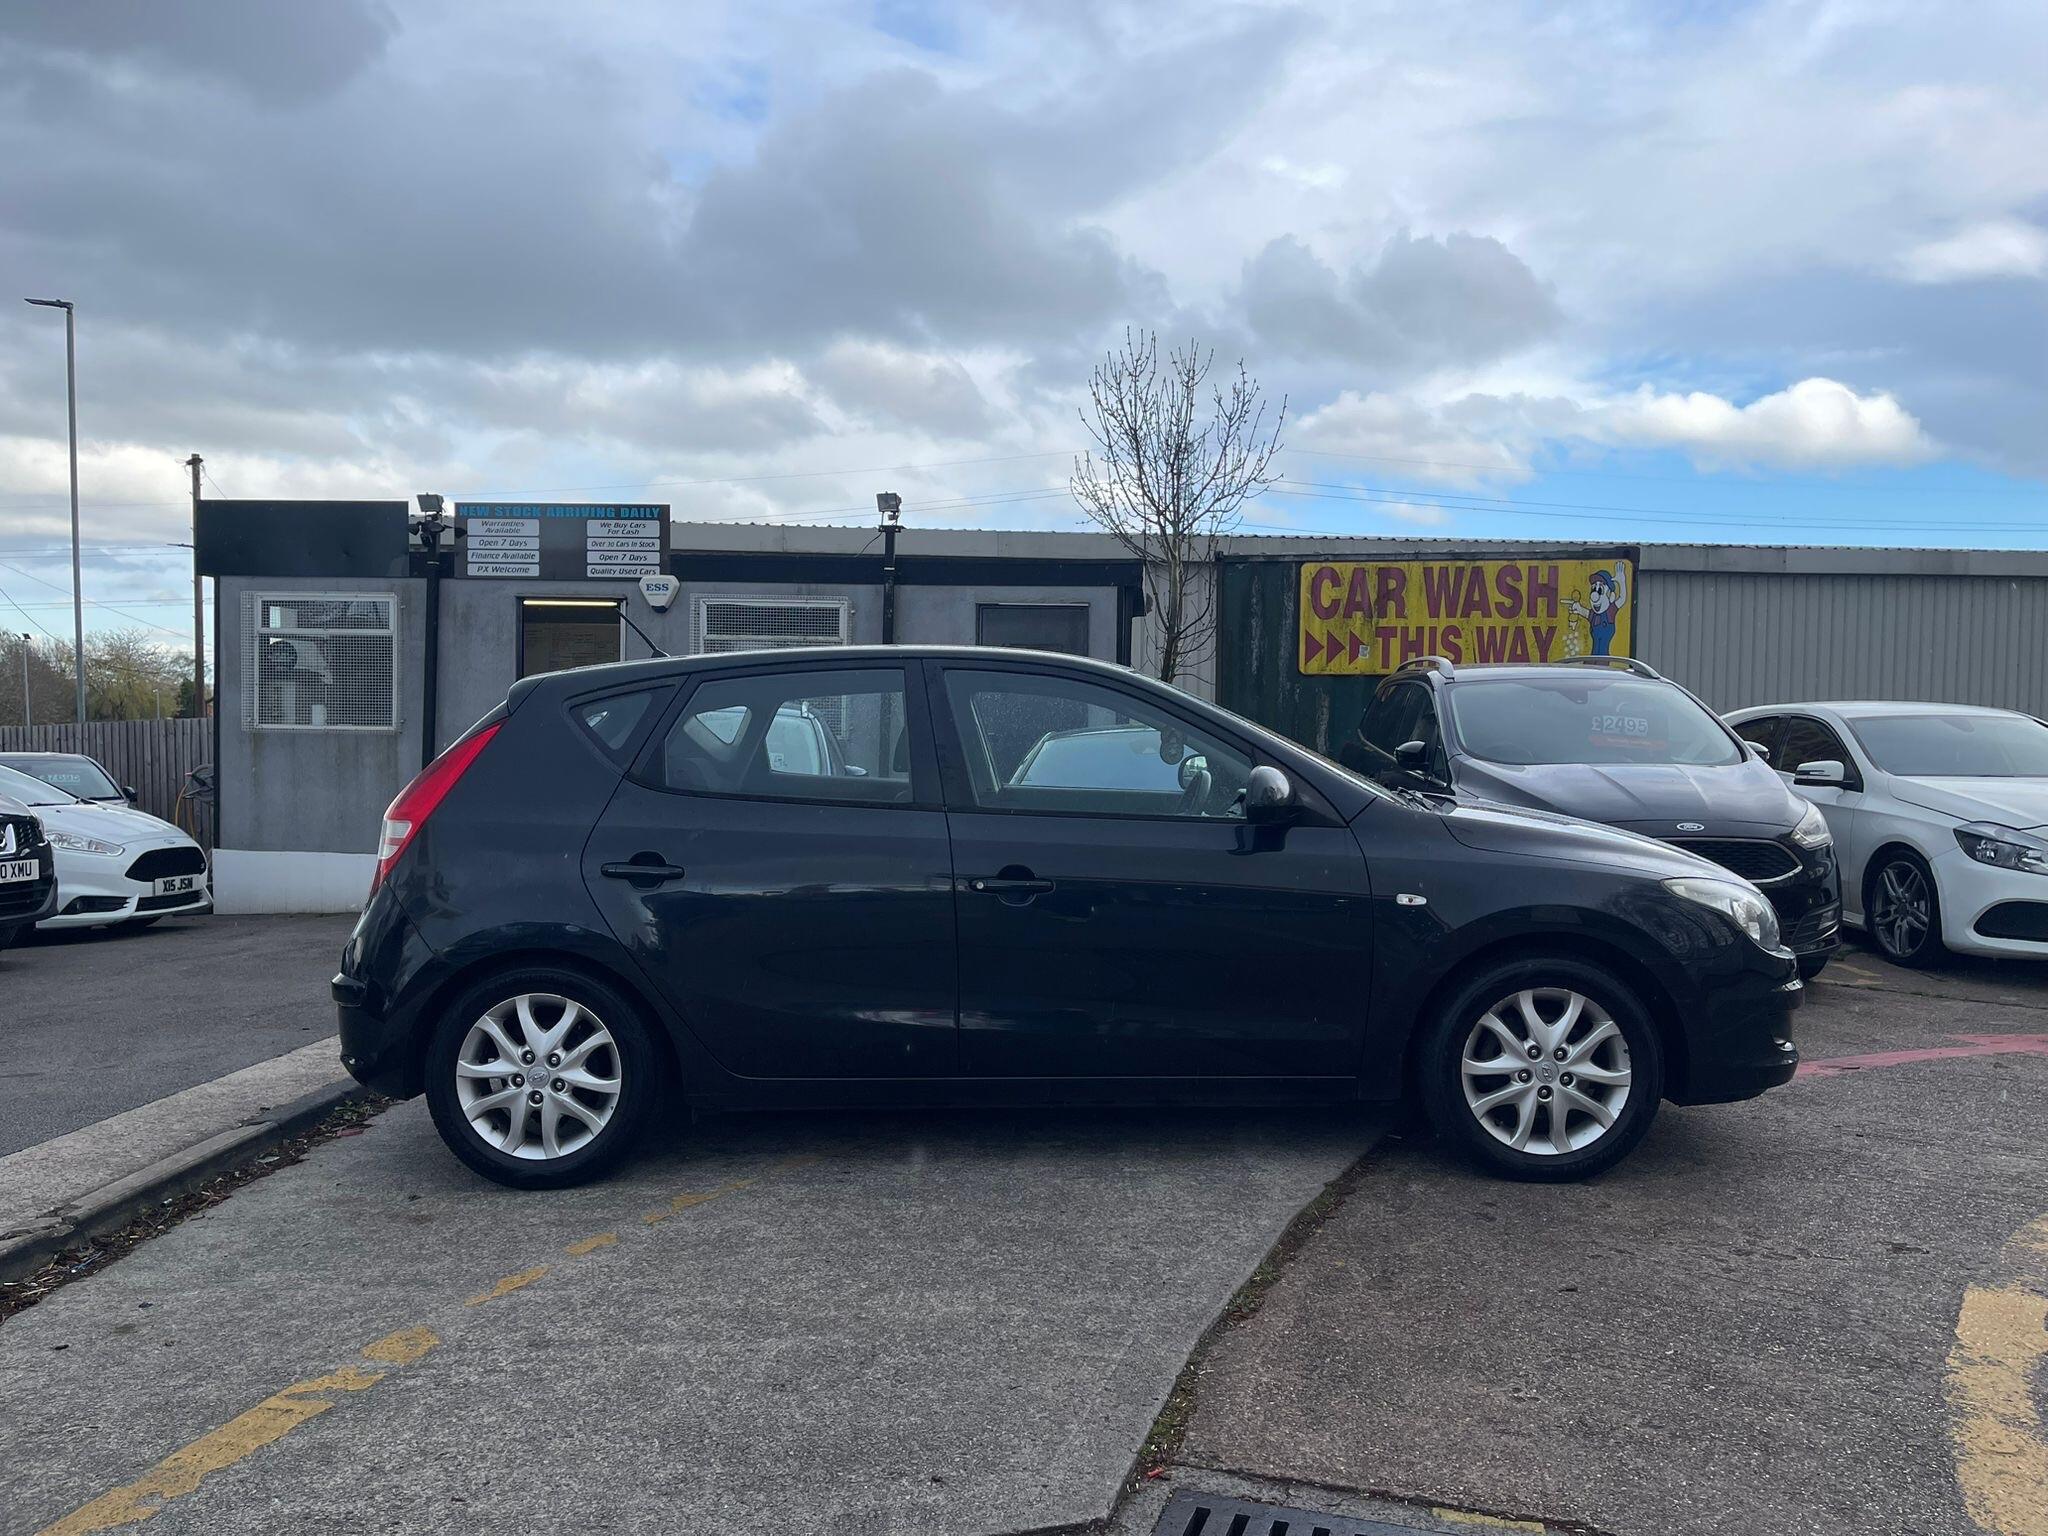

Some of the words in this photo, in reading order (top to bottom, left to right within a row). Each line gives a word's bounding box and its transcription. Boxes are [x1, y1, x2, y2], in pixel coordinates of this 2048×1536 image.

[459, 506, 489, 517] NEW
[495, 506, 541, 517] STOCK
[546, 506, 616, 518] ARRIVING
[620, 507, 661, 518] DAILY
[613, 521, 627, 529] Buy
[629, 521, 646, 529] Cars
[478, 539, 498, 547] Open
[509, 539, 528, 547] Days
[616, 540, 630, 548] Cars
[471, 552, 500, 560] Finance
[501, 552, 536, 560] Available
[599, 553, 619, 562] Open
[621, 553, 627, 561] 7
[629, 554, 648, 562] Days
[590, 567, 617, 576] Quality
[639, 568, 657, 576] Cars
[645, 583, 669, 592] ESS
[1310, 566, 1408, 621] CAR
[1423, 564, 1561, 620] WASH
[1374, 624, 1464, 670] THIS
[1475, 625, 1560, 664] WAY
[10, 861, 32, 878] XMU
[162, 879, 176, 893] X15
[177, 877, 194, 891] JSN
